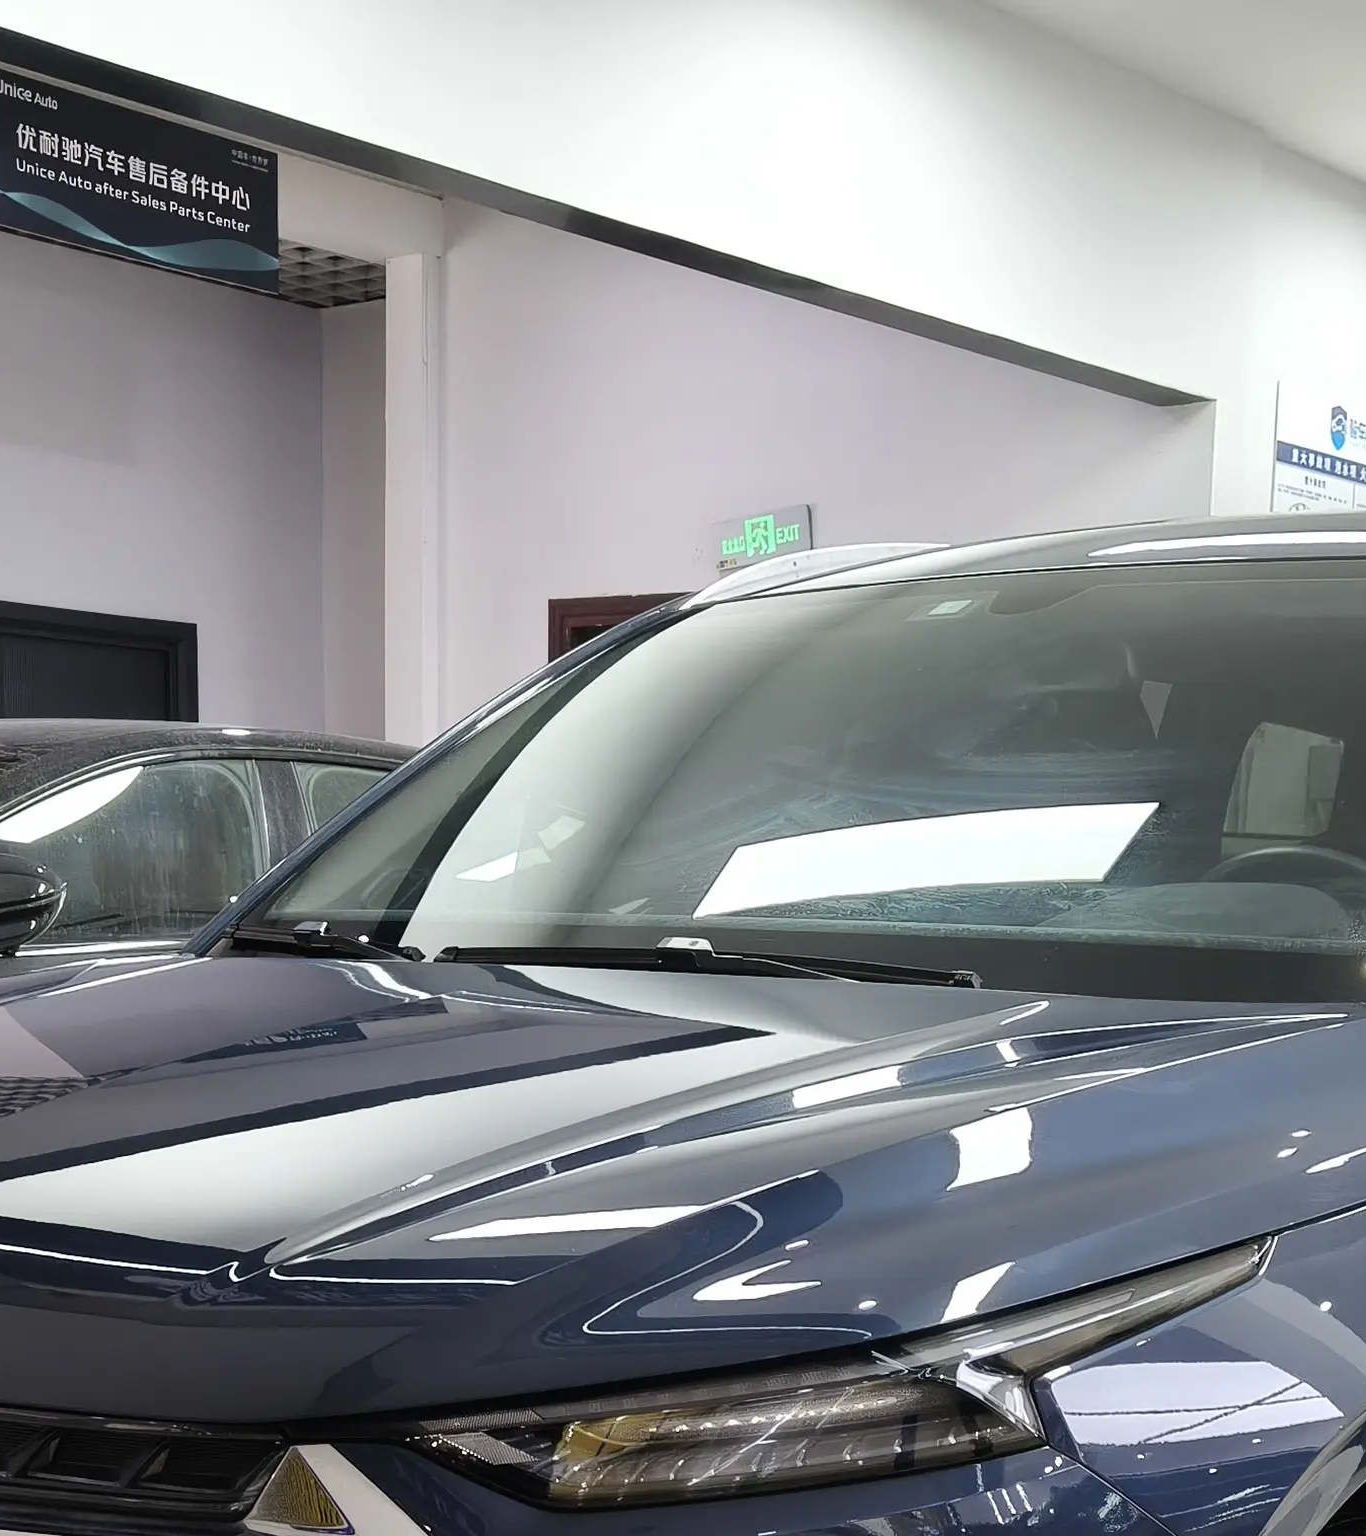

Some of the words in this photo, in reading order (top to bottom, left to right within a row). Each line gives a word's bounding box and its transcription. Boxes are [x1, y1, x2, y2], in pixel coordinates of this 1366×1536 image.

[34, 92, 58, 110] Auto
[16, 123, 250, 211] 优耐驰汽车售后备件中心
[16, 158, 55, 181] Unice
[58, 171, 92, 190] Auto
[95, 182, 129, 200] after
[131, 190, 167, 211] Sales
[170, 201, 204, 221] Parts
[207, 211, 251, 232] Center
[776, 523, 800, 544] EXIT
